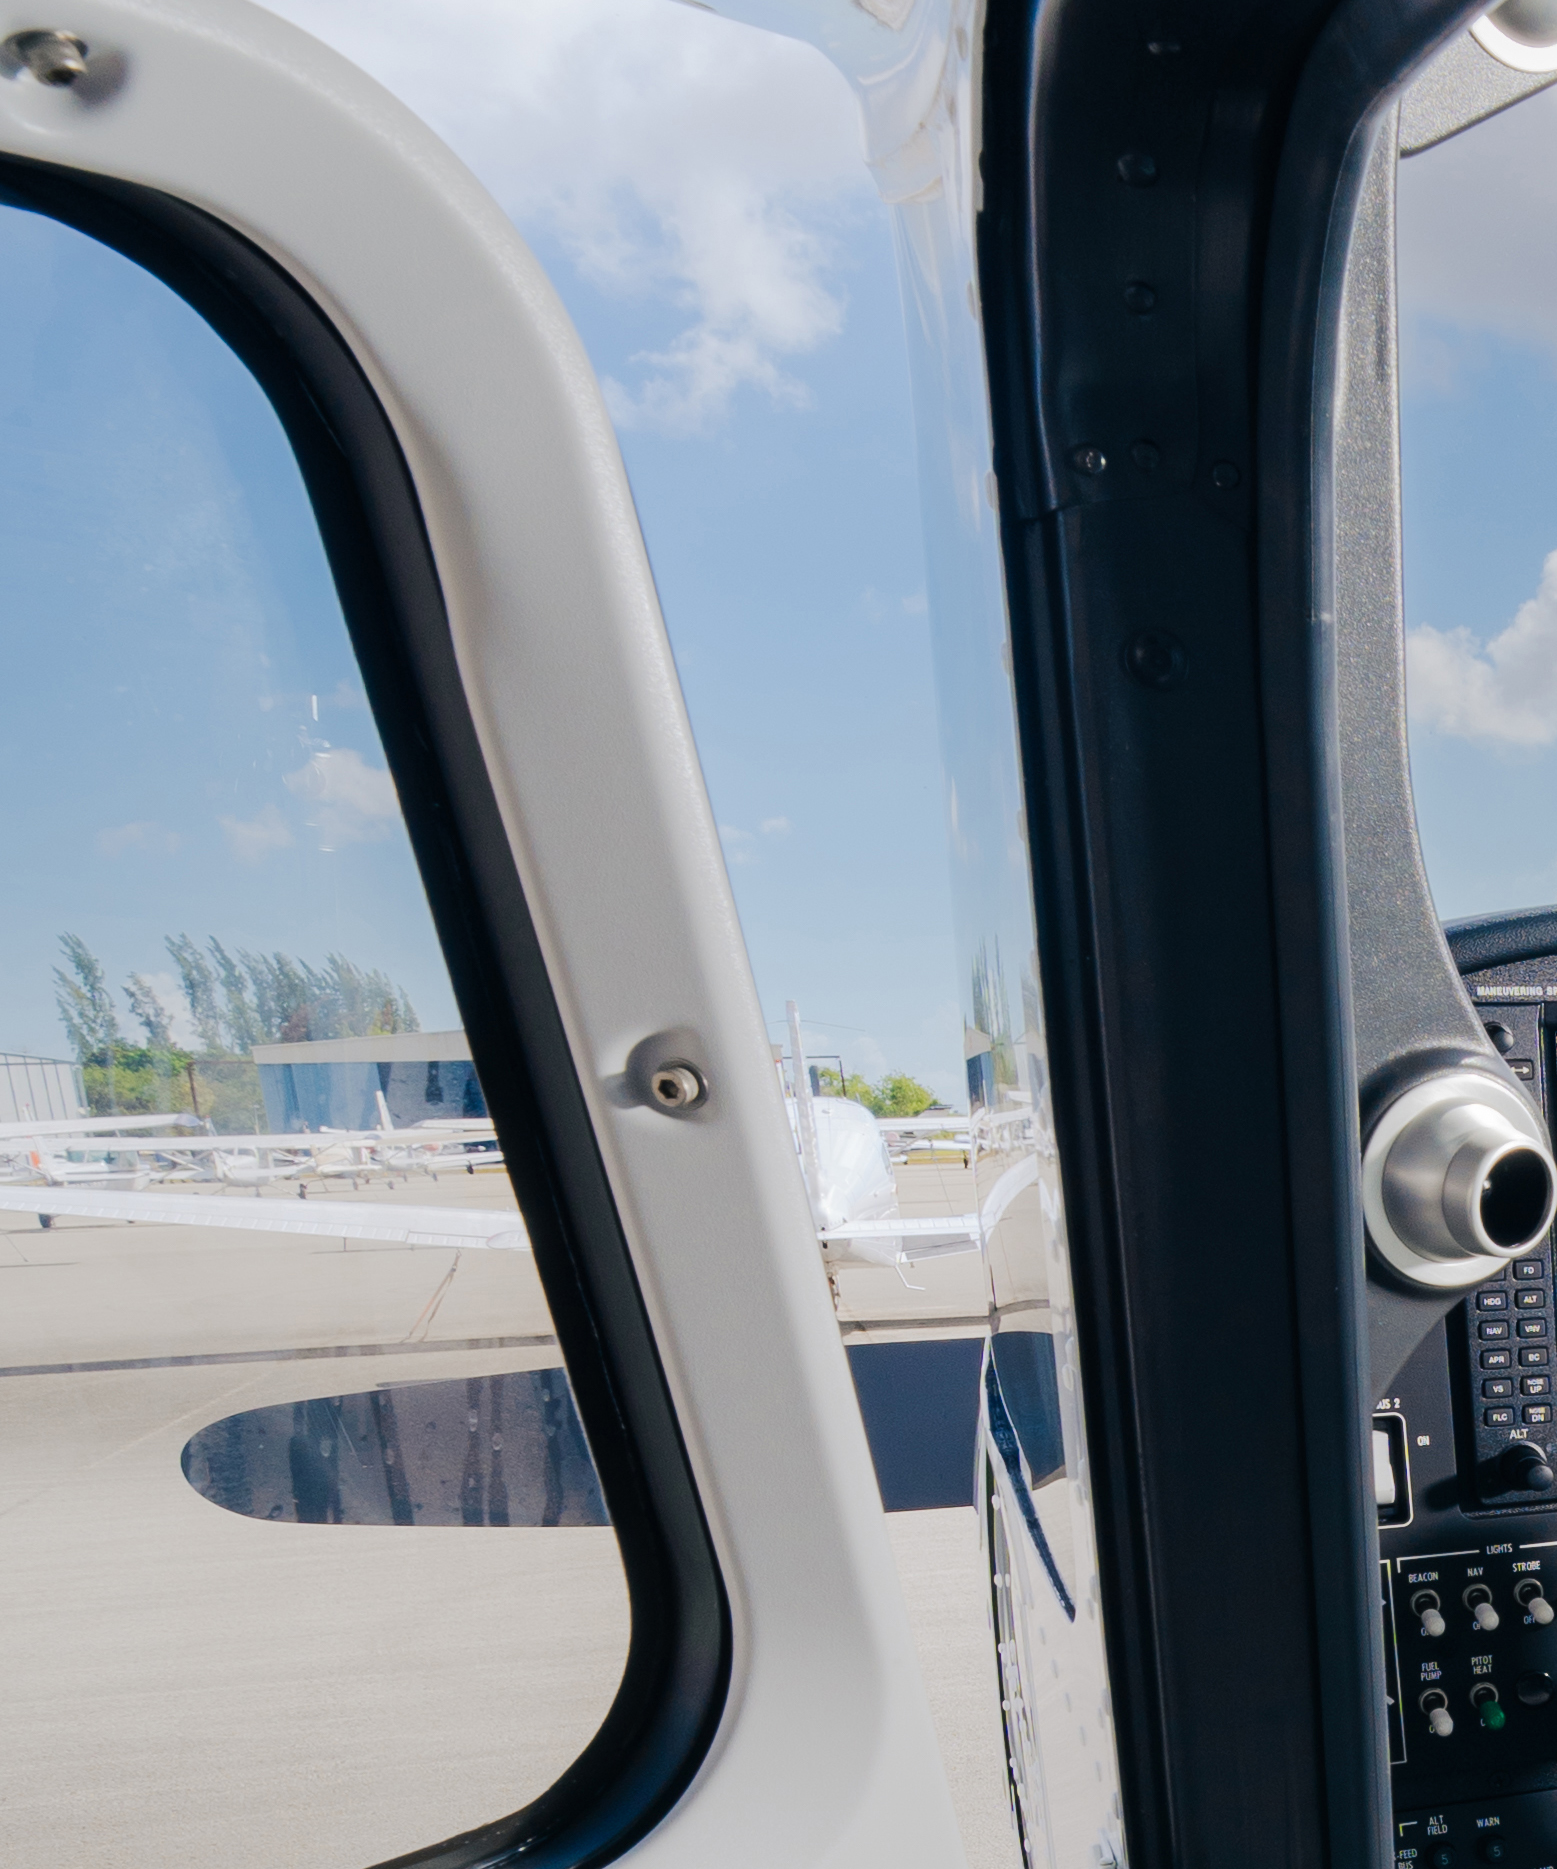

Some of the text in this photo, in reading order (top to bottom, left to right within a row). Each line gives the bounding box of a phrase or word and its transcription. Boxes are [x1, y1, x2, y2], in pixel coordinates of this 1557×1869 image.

[1477, 986, 1543, 996] MANEUVERING
[1487, 1327, 1502, 1335] NAV
[1510, 1429, 1528, 1439] ALT
[1487, 1544, 1512, 1554] LIGHTS
[1512, 1561, 1541, 1572] STROBE
[1467, 1568, 1483, 1576] NAV
[1408, 1572, 1438, 1583] BEACON
[1471, 1656, 1492, 1665] PITOT
[1422, 1663, 1439, 1672] FUEL
[1473, 1664, 1492, 1674] HEAT
[1421, 1671, 1441, 1681] PUMP
[1429, 1815, 1443, 1825] ALT
[1476, 1817, 1500, 1827] WARN
[1427, 1825, 1447, 1835] FIELD
